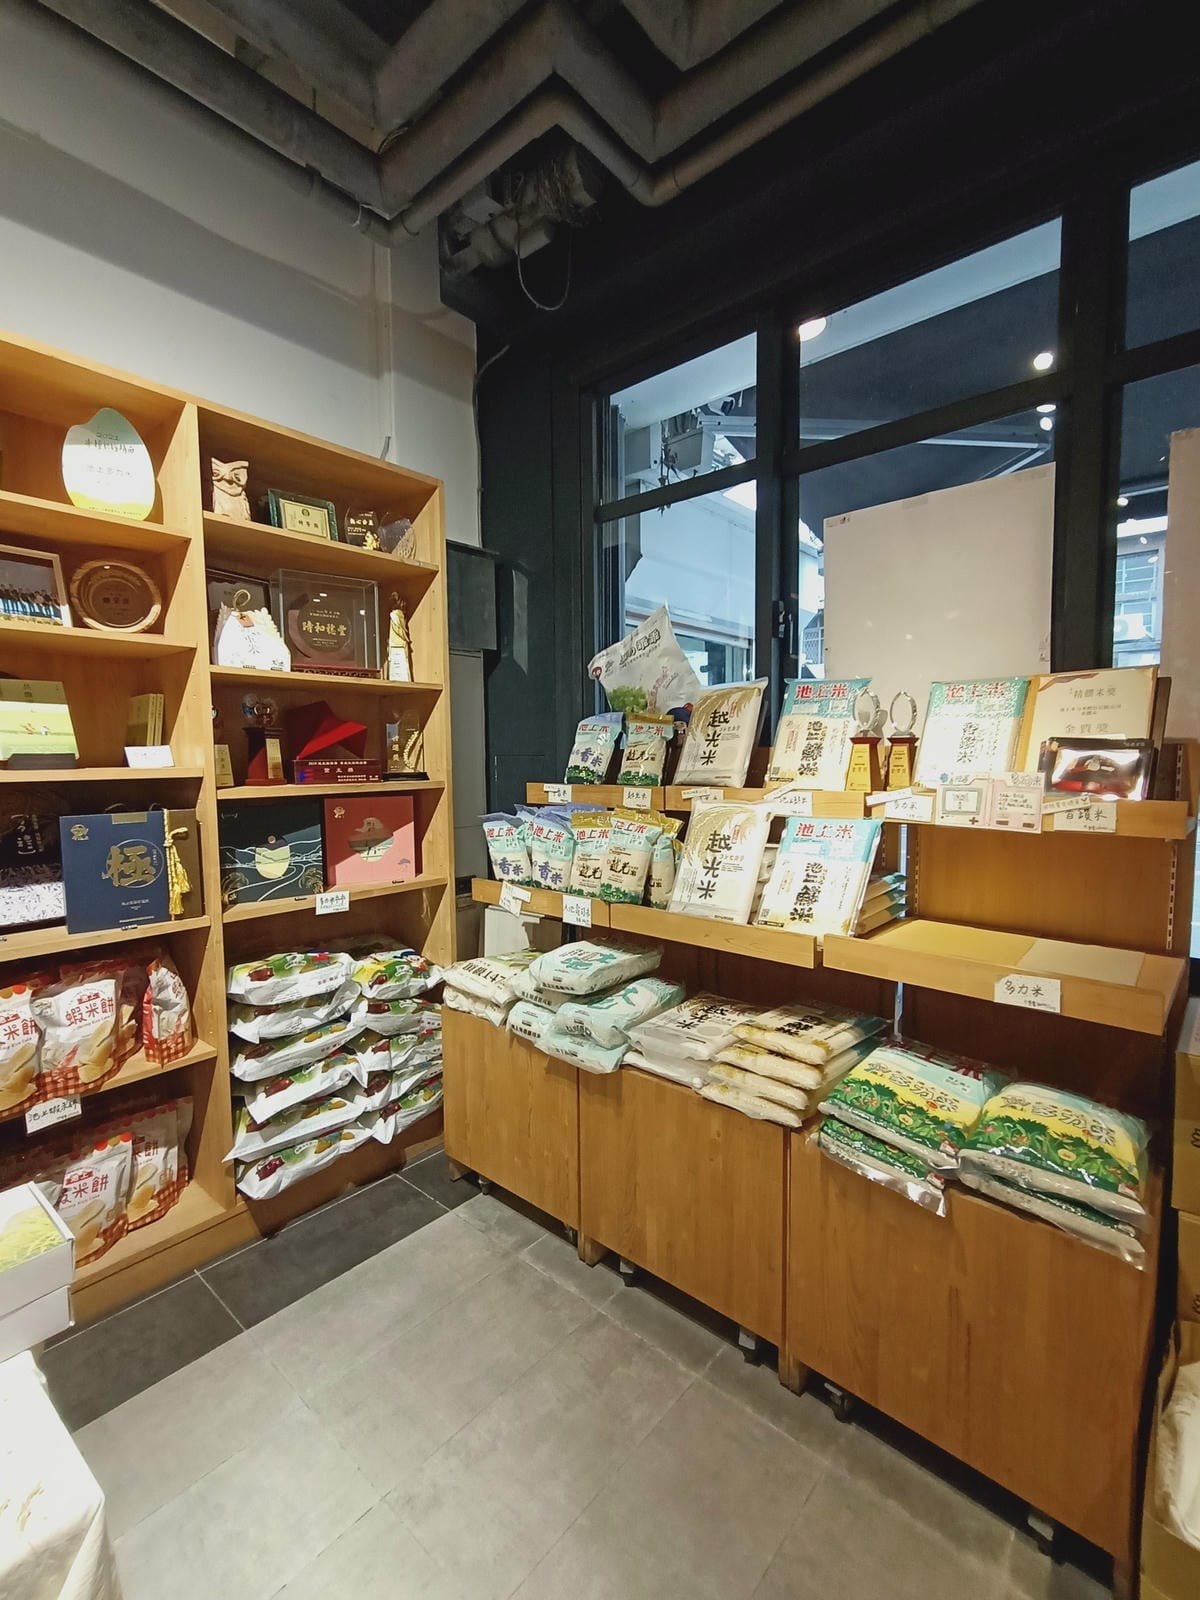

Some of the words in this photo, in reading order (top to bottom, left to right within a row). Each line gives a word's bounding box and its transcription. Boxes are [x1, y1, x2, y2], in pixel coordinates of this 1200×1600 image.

[795, 685, 847, 699] 池上米
[945, 682, 1006, 699] 池上米
[700, 709, 730, 766] 越光米
[487, 826, 514, 838] 池上米
[533, 825, 564, 842] 池上米
[577, 829, 609, 840] 池上米
[796, 823, 854, 839] 池上米
[102, 845, 156, 887] 極
[498, 857, 523, 877] 香米
[538, 861, 563, 885] 香米
[697, 830, 732, 899] 越光米
[1005, 979, 1044, 997] 多力米
[65, 997, 113, 1027] 蝦米餅
